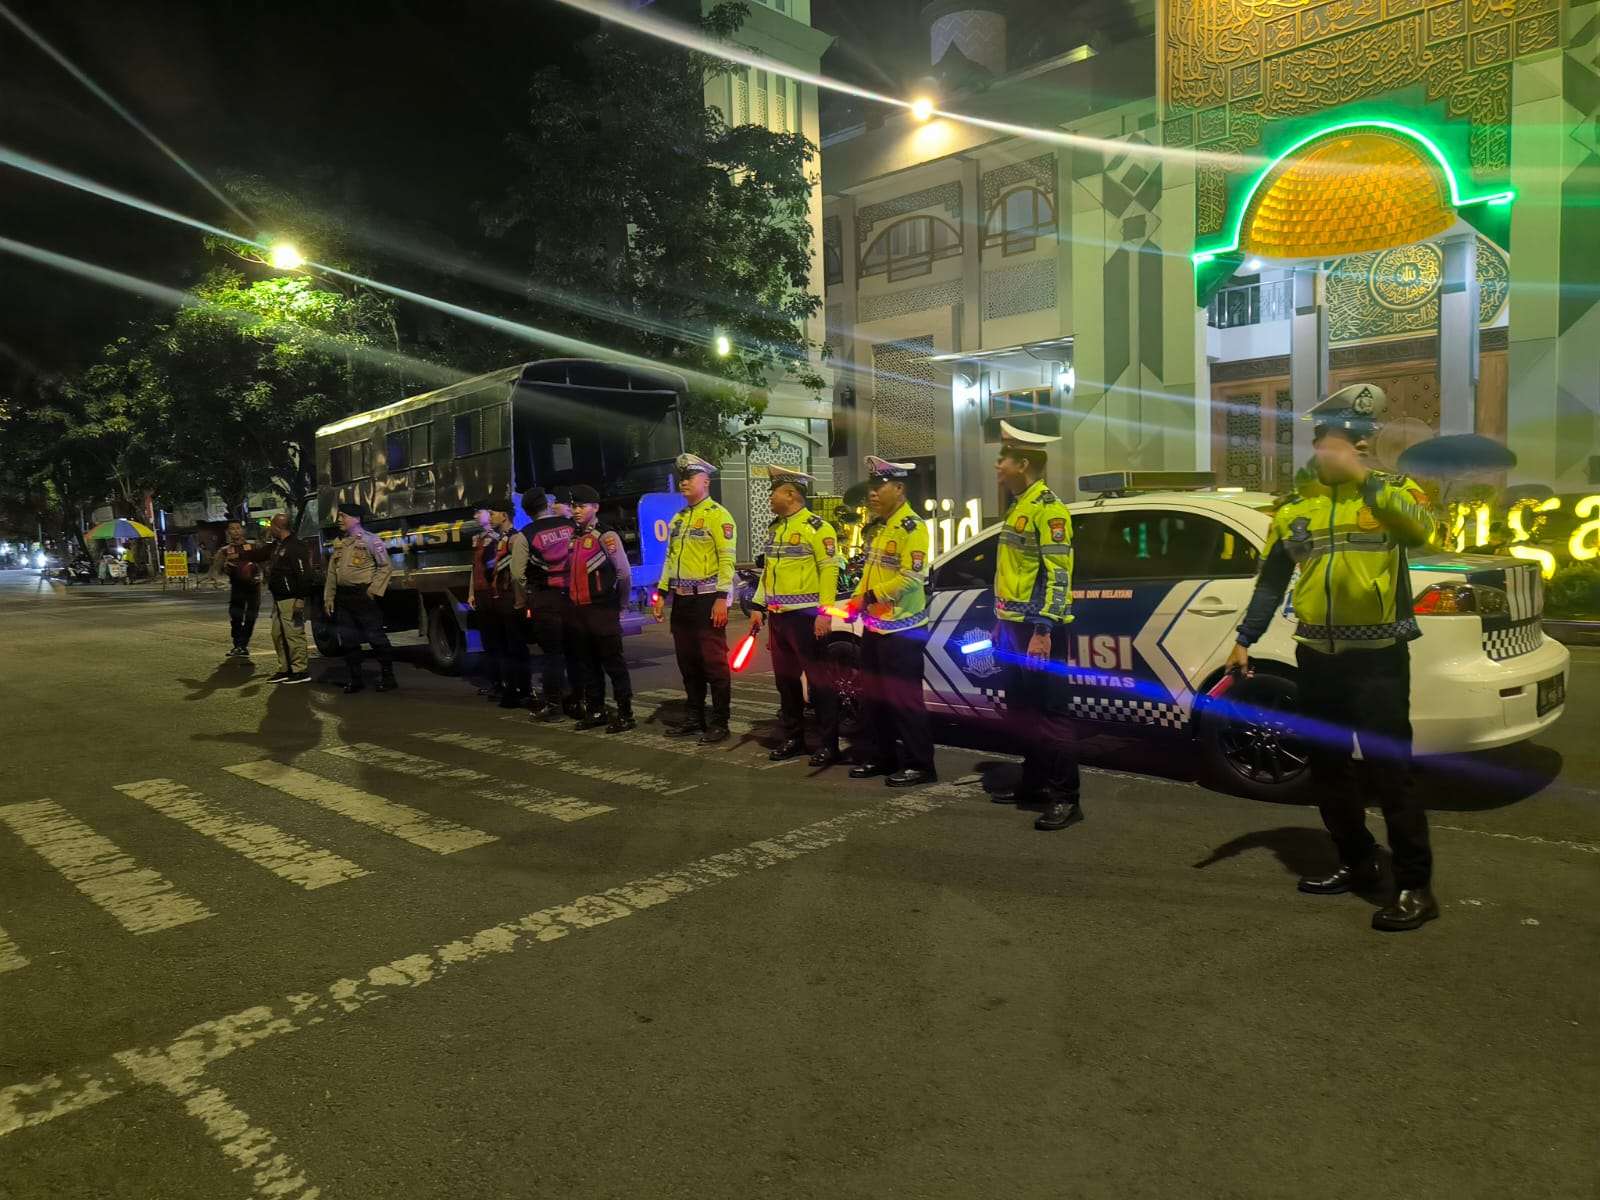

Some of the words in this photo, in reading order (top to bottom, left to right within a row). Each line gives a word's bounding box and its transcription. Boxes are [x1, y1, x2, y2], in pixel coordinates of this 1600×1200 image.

[540, 528, 571, 545] POLISI
[654, 519, 670, 542] 0
[1067, 674, 1135, 688] LINTAS
